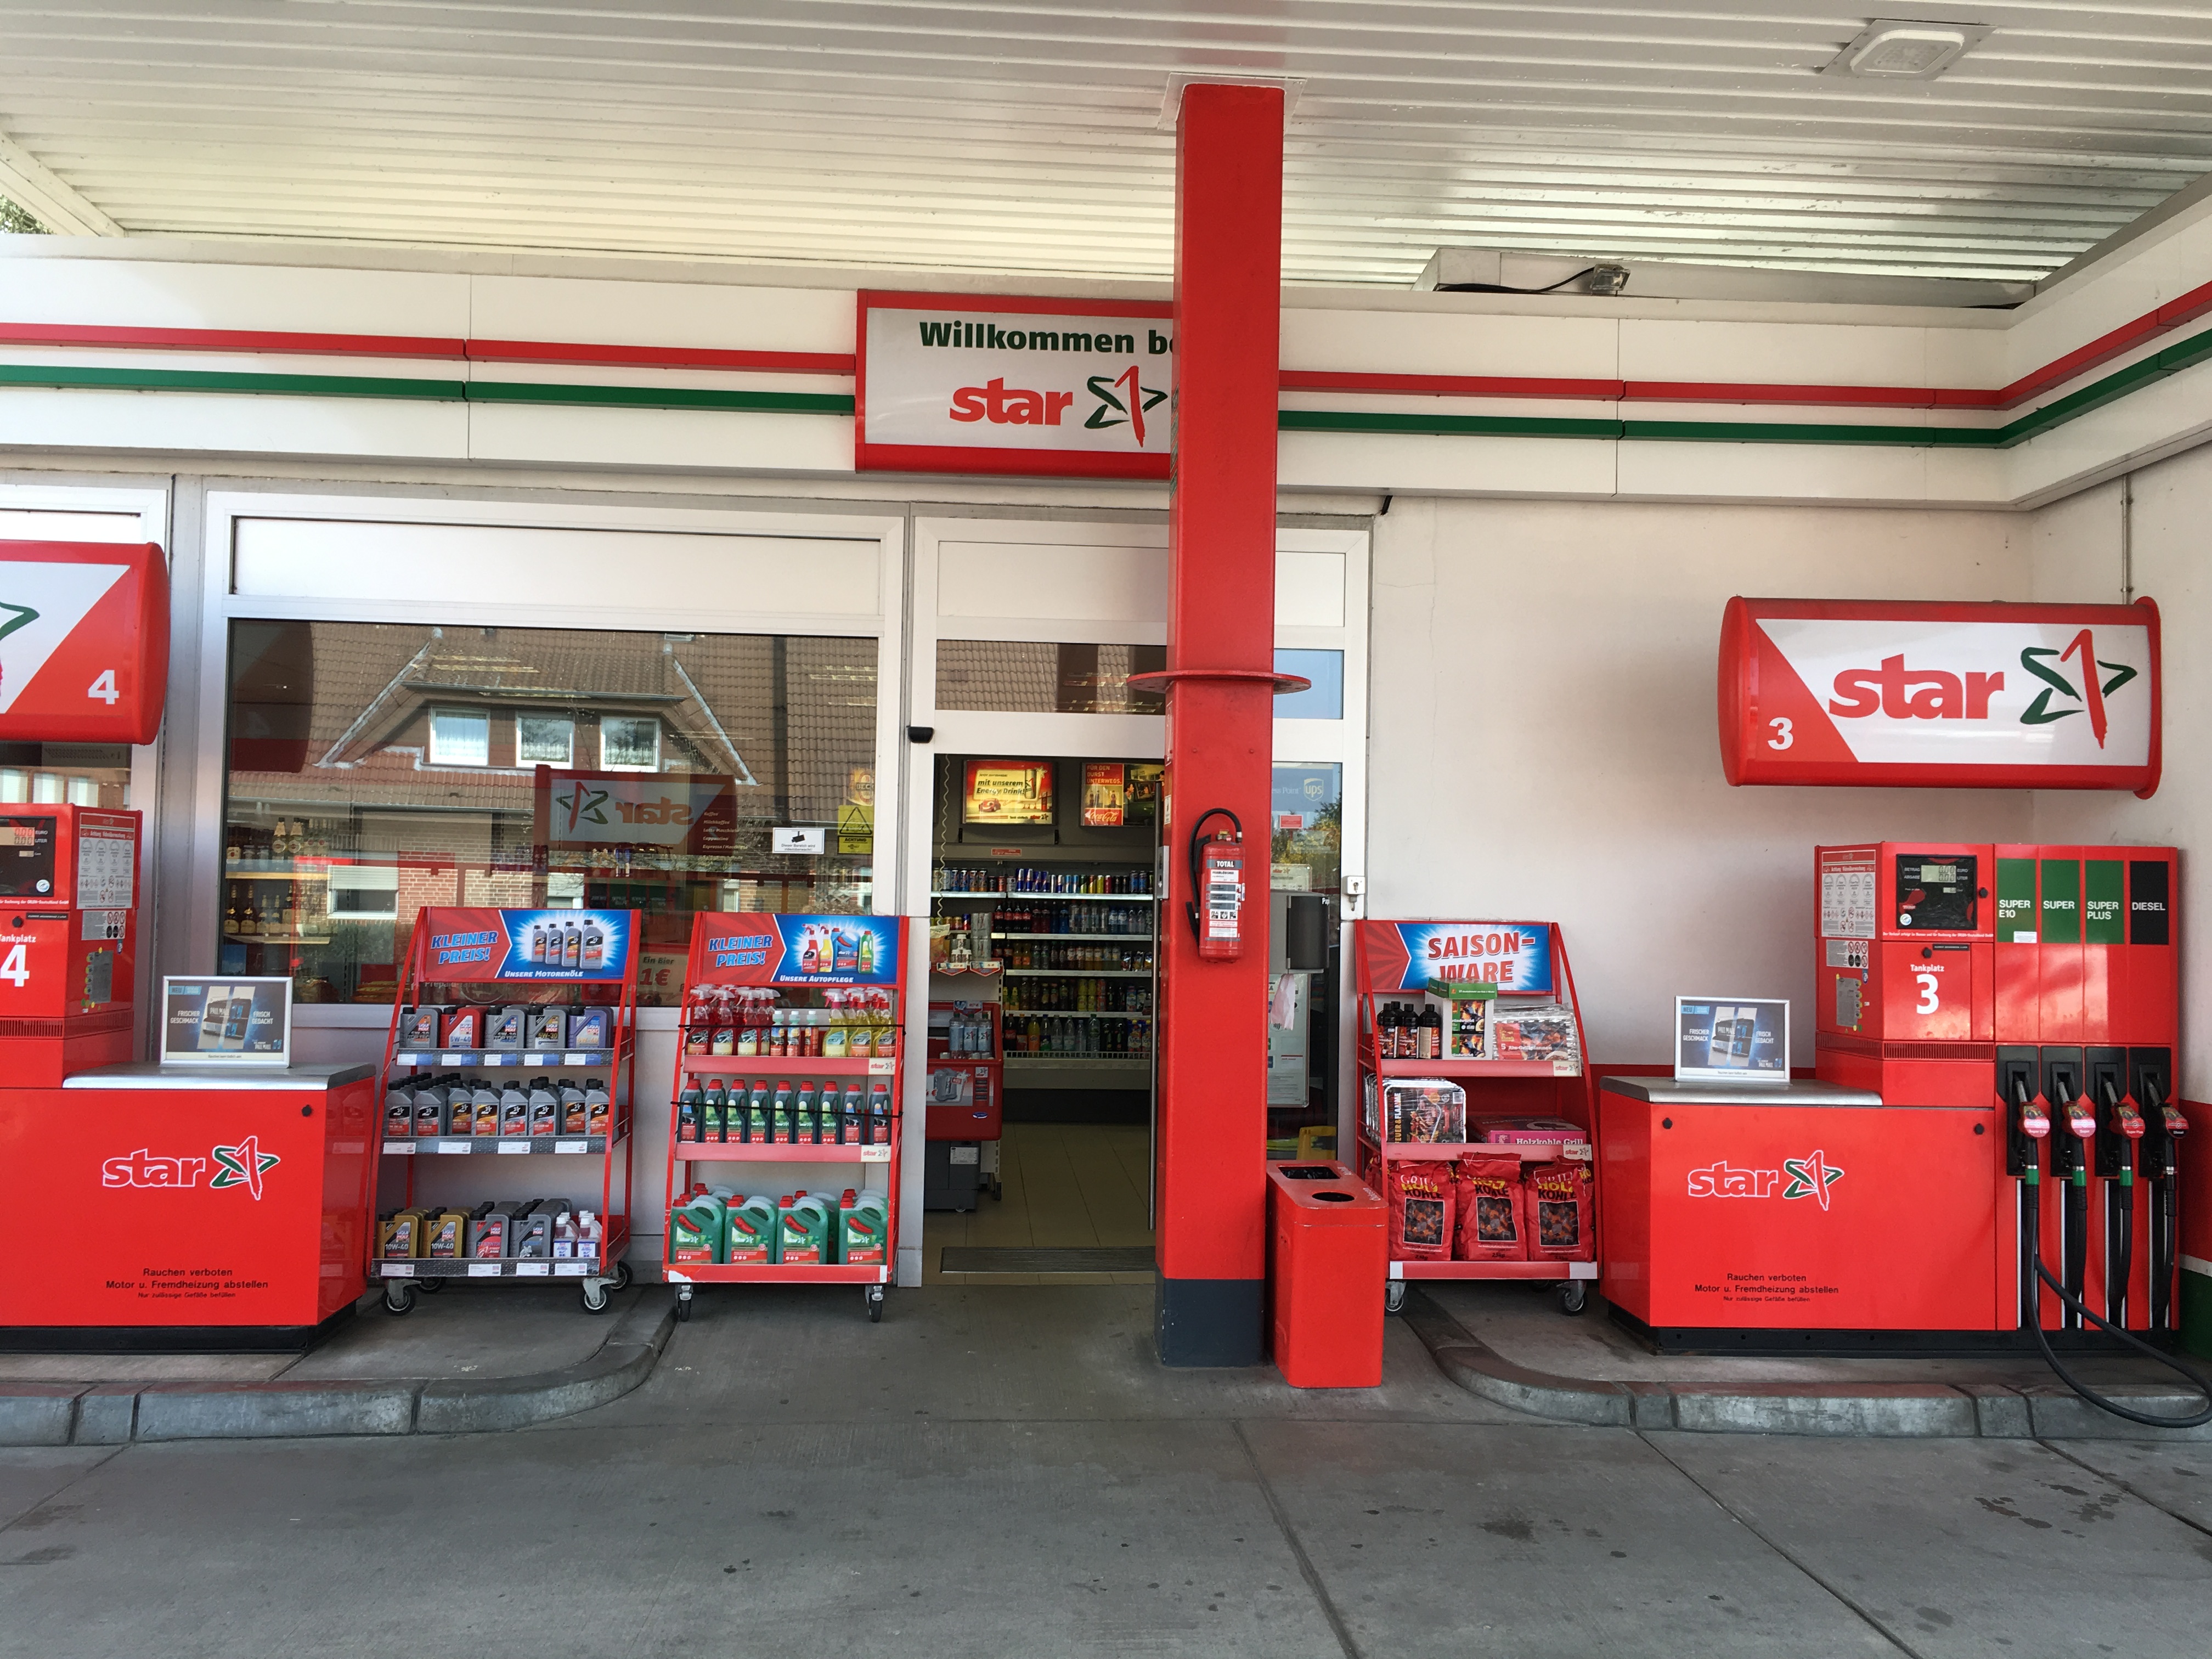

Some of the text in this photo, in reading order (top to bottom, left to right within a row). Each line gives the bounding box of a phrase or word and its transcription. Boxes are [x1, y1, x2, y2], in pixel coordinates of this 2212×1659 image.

[919, 321, 1135, 354] Willkommen
[949, 377, 1073, 426] star
[88, 669, 120, 704] 4
[1829, 653, 2005, 719] star
[1768, 717, 1793, 751] 3
[1305, 785, 1323, 798] ups
[1999, 900, 2030, 909] SUPER
[2043, 901, 2075, 909] SUPER
[2087, 901, 2119, 910] SUPER
[2131, 902, 2166, 911] DIESEL
[1999, 910, 2016, 918] E10
[2087, 911, 2112, 920] PLUS
[0, 934, 37, 944] ankplatz
[431, 930, 499, 950] KLEINER
[708, 935, 774, 952] KLEINER
[1427, 932, 1536, 960] SAISON-
[438, 947, 490, 965] PREIS!
[715, 951, 766, 968] PREIS!
[0, 944, 30, 987] 4
[1439, 961, 1514, 983] WARE
[1910, 964, 1945, 973] Tankplatz
[1916, 973, 1939, 1015] 3
[103, 1148, 206, 1188] star
[1688, 1160, 1779, 1198] star
[1405, 1189, 1444, 1199] KOHLE
[1538, 1188, 1577, 1201] KOHLE
[143, 1268, 233, 1277] Rauchen verboten
[1727, 1273, 1807, 1282] Rauchen verboten
[106, 1281, 135, 1289] Motor
[151, 1280, 219, 1290] Fremdheizung
[224, 1281, 268, 1289] abstellen
[1695, 1284, 1720, 1293] Motor
[1735, 1285, 1796, 1294] Fremdheizung
[1799, 1286, 1839, 1294] abstellen
